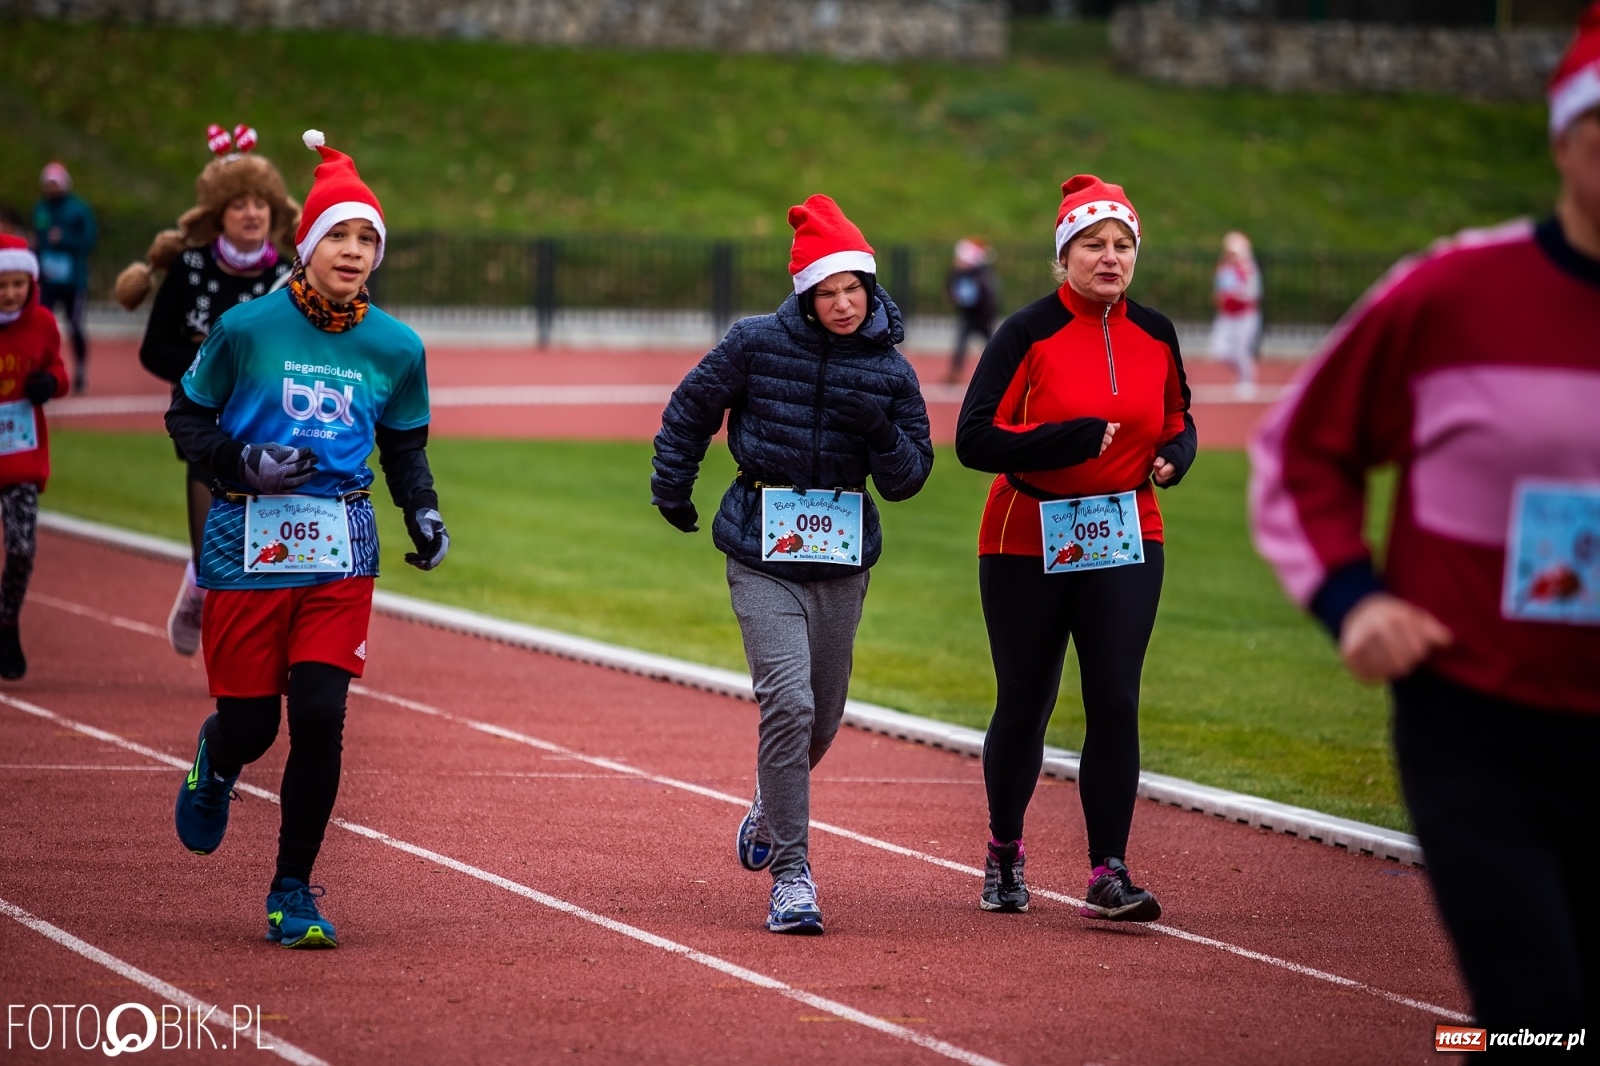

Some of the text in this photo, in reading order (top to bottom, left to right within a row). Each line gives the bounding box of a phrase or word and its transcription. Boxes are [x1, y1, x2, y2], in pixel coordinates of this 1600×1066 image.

[284, 360, 362, 382] BiegamBoLubię
[282, 377, 355, 427] bbl
[257, 507, 281, 519] Bieg
[773, 501, 796, 511] Bieg
[796, 513, 832, 533] 099
[1051, 512, 1073, 524] Bieg
[279, 520, 320, 541] 065
[1074, 519, 1110, 541] 095
